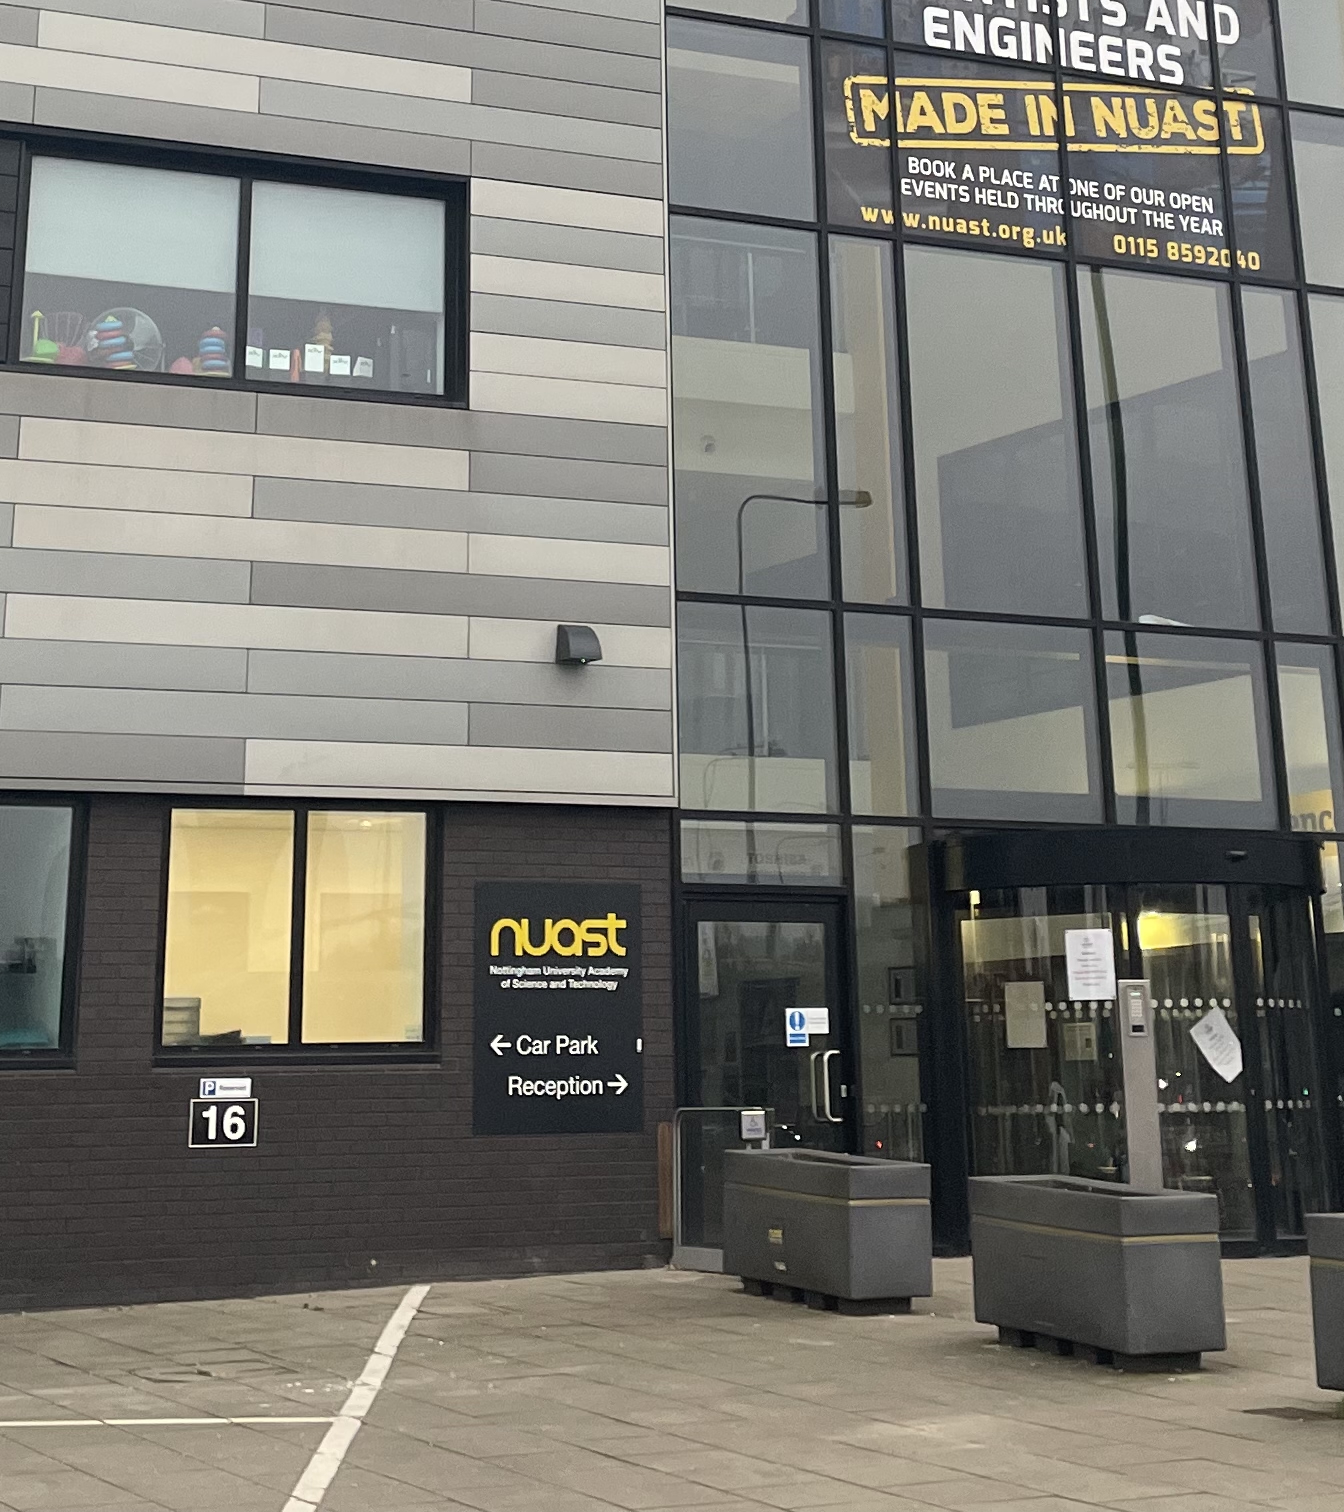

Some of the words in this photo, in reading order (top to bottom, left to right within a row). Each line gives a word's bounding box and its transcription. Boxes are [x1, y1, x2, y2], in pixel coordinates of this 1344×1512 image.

[923, 6, 1184, 85] ENGINEERS
[859, 88, 1010, 135] MADE
[1024, 94, 1075, 137] IN
[1090, 95, 1247, 141] NUAST
[900, 178, 970, 203] EVENTS
[974, 187, 1019, 210] HELD
[1142, 209, 1176, 230] THE
[1179, 214, 1224, 237] YEAR
[907, 156, 956, 179] BOOK
[961, 163, 975, 182] A
[978, 165, 1034, 190] PLACE
[1038, 174, 1060, 192] AT
[1103, 183, 1126, 201] OF
[1130, 187, 1165, 208] OUR
[1169, 192, 1214, 214] OPEN
[860, 206, 1067, 249] www.nuast.org.uk
[1113, 234, 1159, 258] 0115
[1167, 241, 1261, 271] 8592040
[490, 912, 627, 957] nuast
[489, 965, 541, 978] Nottingham
[542, 965, 587, 978] University
[587, 966, 629, 978] Academy
[500, 979, 511, 988] of
[511, 979, 548, 989] Science
[549, 979, 567, 989] and
[568, 979, 618, 991] Technology
[516, 1035, 551, 1055] Car
[555, 1035, 599, 1055] Park
[508, 1075, 604, 1099] Reception
[201, 1104, 246, 1141] 16
